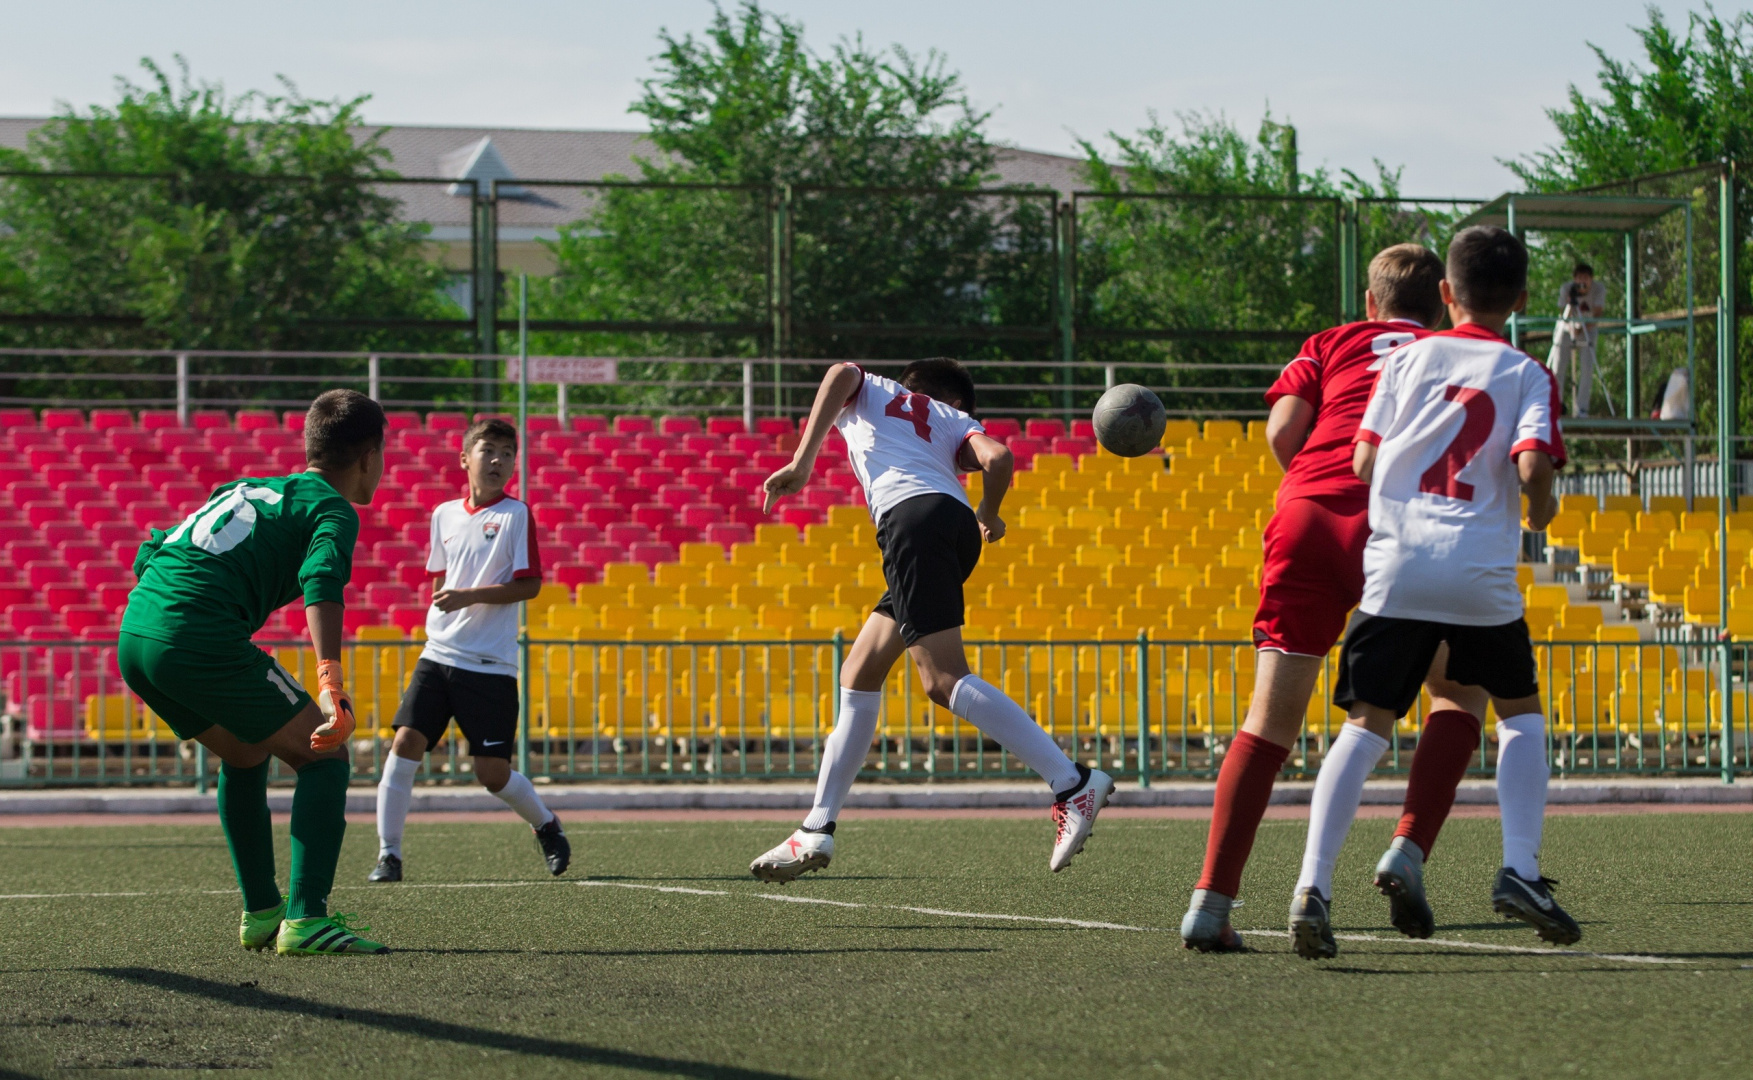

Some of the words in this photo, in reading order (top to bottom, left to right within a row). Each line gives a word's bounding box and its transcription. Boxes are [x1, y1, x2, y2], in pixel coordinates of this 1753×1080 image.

[885, 391, 932, 443] 4
[1418, 384, 1495, 501] 2
[163, 482, 284, 554] 16
[1086, 788, 1095, 821] adidas
